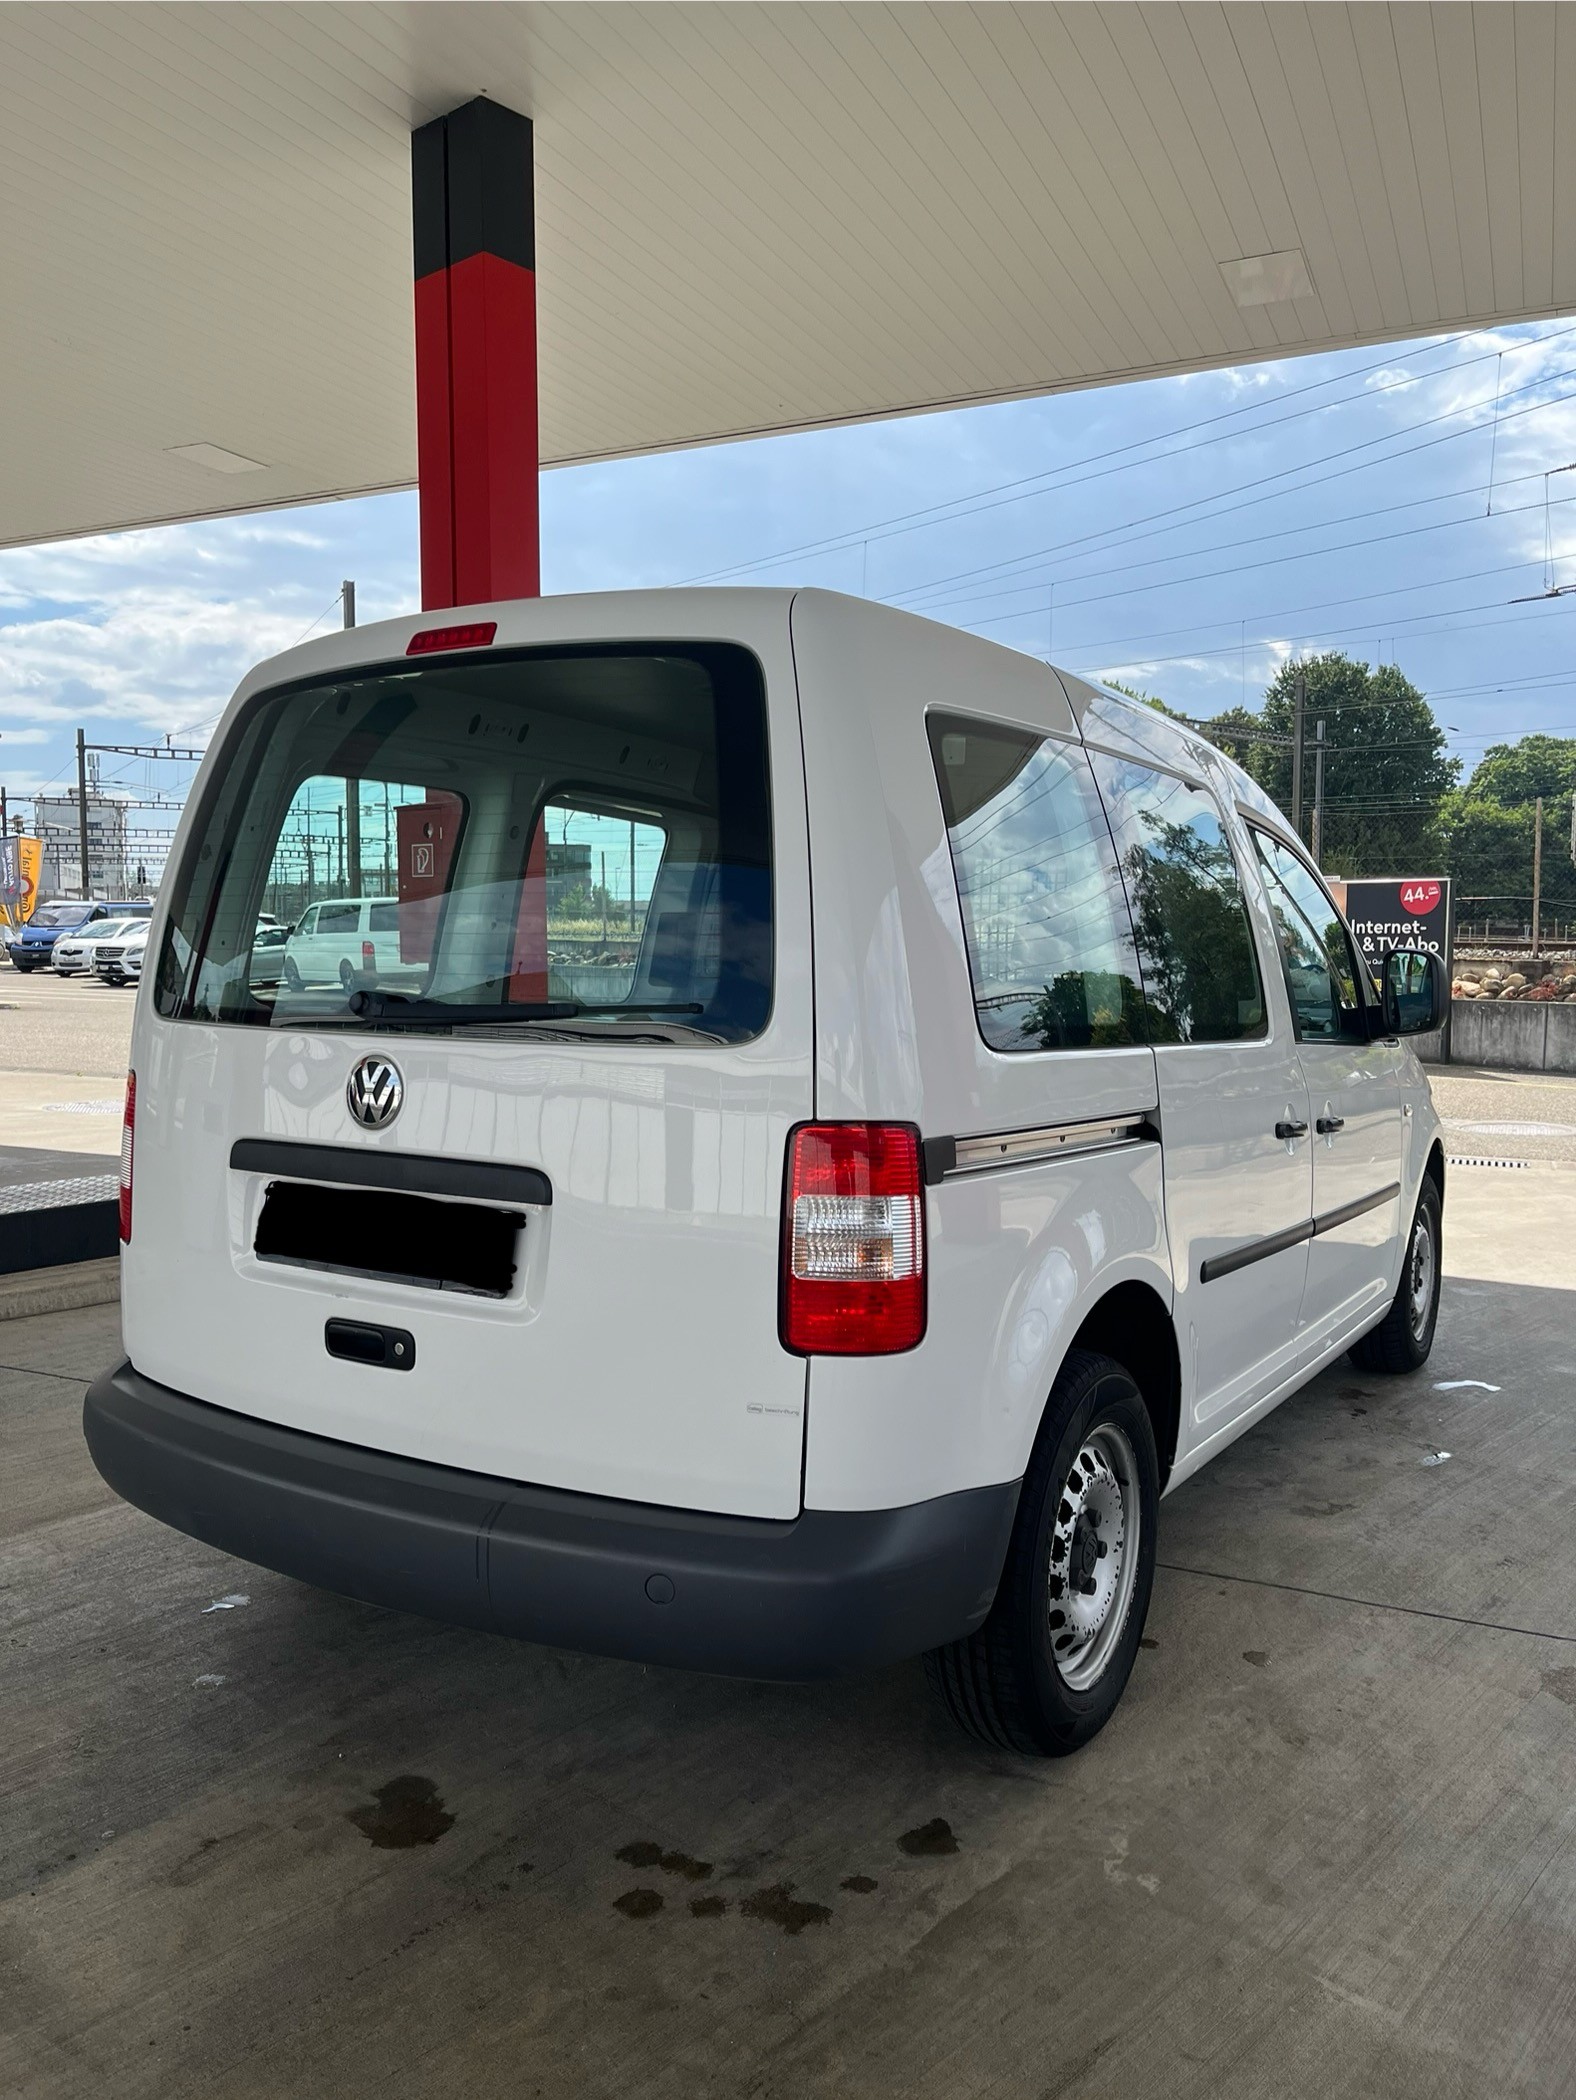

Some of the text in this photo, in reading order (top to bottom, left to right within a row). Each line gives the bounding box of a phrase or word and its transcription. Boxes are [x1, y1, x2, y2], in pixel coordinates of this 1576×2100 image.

[1351, 919, 1427, 935] Internet-
[1362, 936, 1439, 952] & TV-Abo
